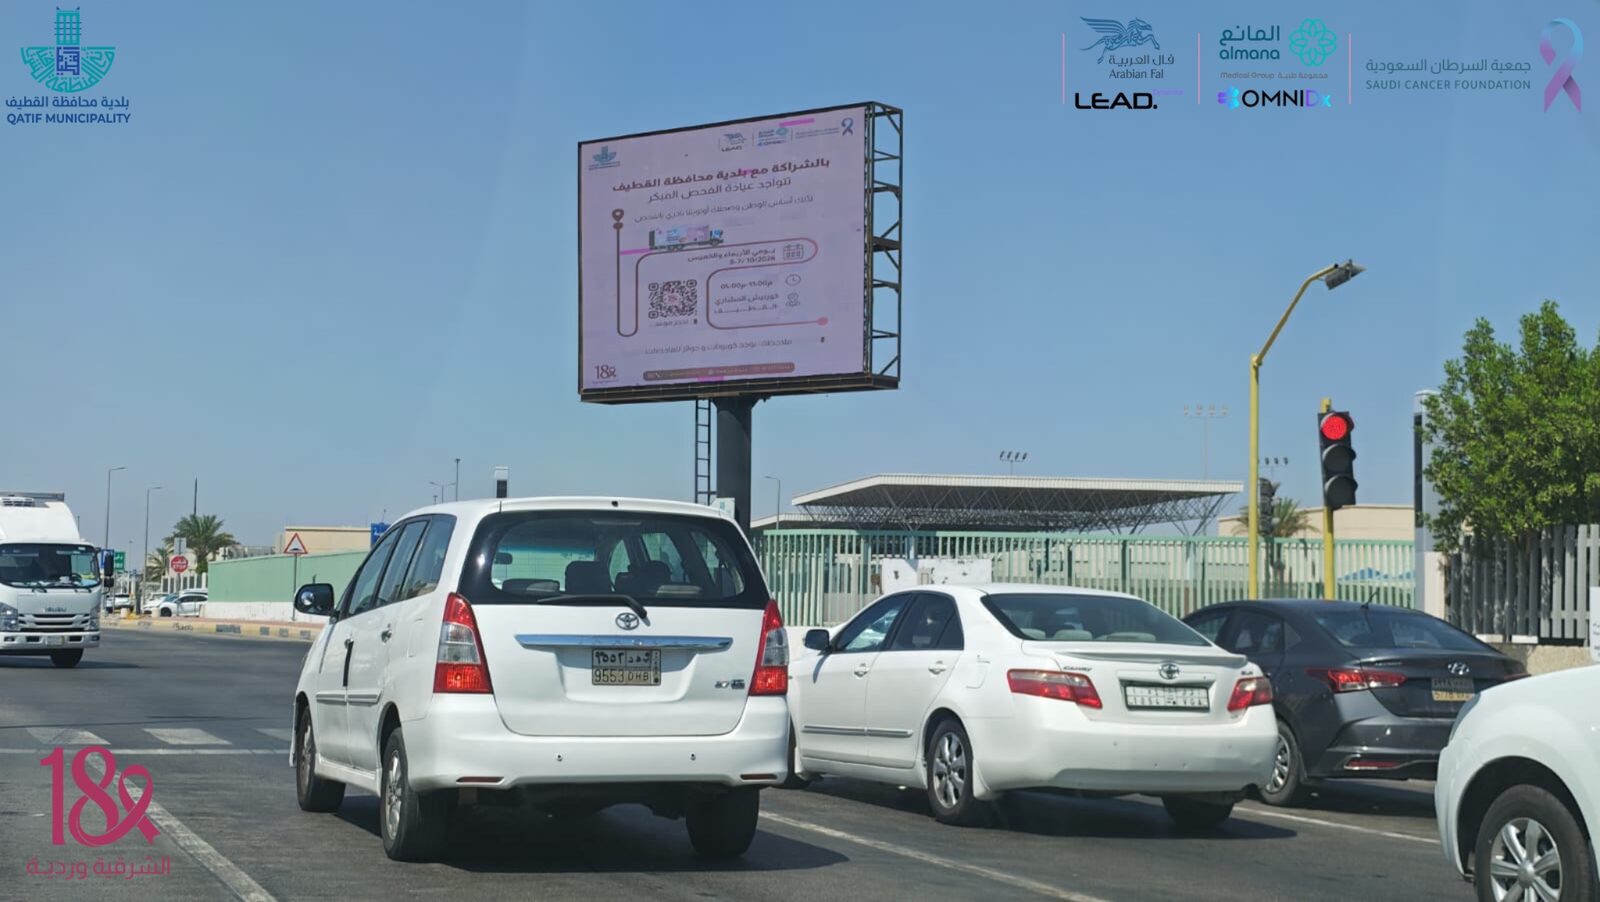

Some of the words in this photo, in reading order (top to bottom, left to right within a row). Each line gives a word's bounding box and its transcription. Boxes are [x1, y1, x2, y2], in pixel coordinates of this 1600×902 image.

[772, 157, 830, 173] بالشراكة
[664, 172, 713, 186] محافظة
[716, 167, 747, 180] بلدية
[750, 168, 768, 179] مع
[612, 177, 660, 192] القطيف
[725, 181, 753, 193] عيادة
[758, 177, 791, 189] تتواجد
[647, 189, 679, 203] المبكر
[681, 184, 722, 200] الفحص
[594, 668, 625, 683] 9553
